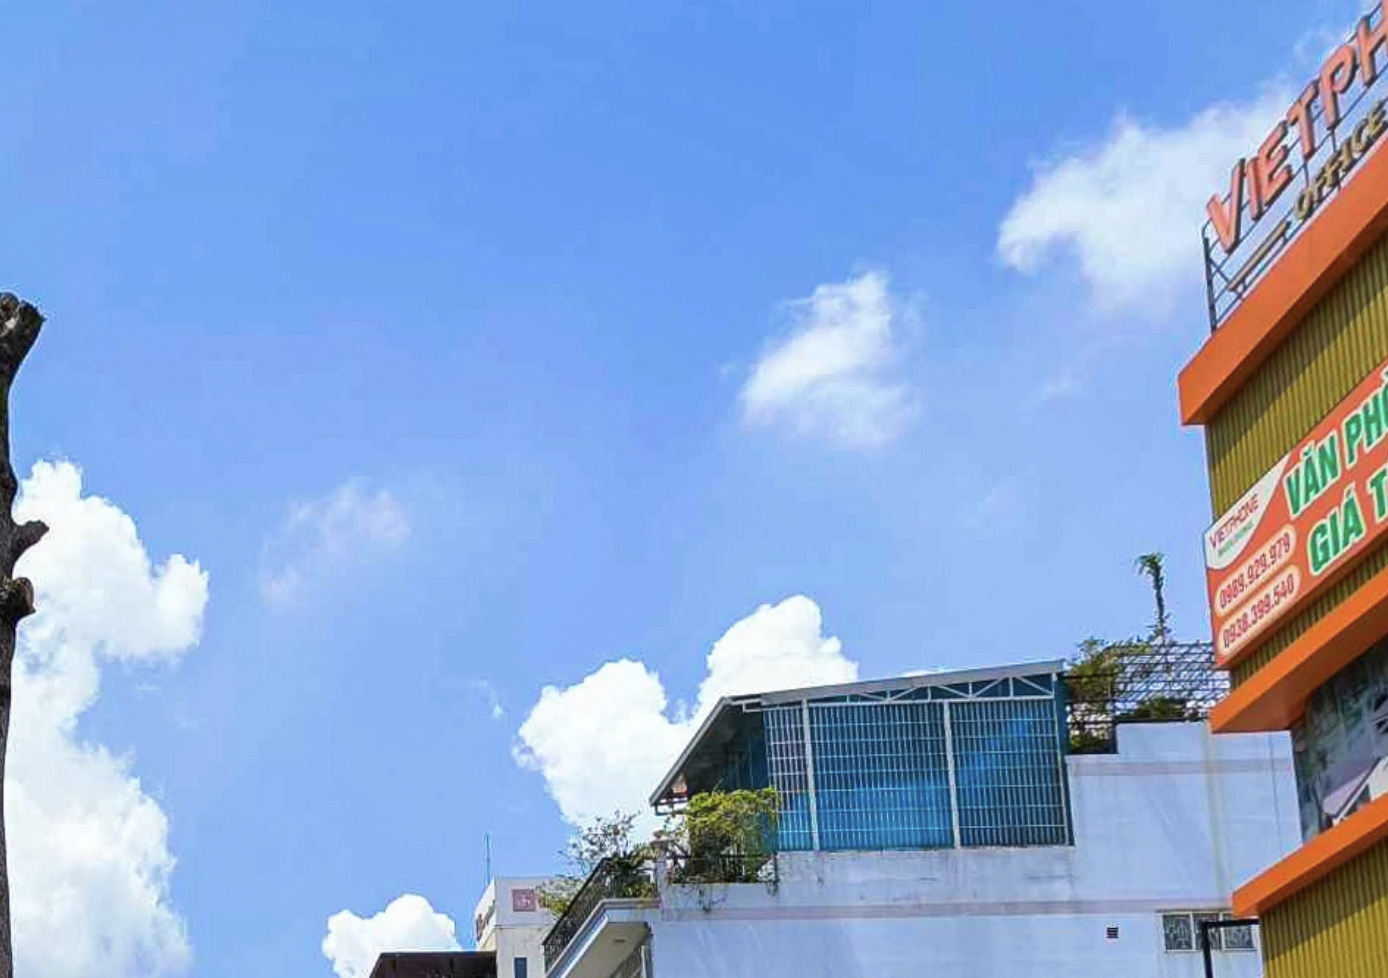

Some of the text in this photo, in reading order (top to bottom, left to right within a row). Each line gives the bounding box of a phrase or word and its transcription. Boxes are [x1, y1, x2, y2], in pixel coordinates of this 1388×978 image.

[1284, 430, 1340, 518] VĂN
[1209, 494, 1258, 548] VIETPHONE
[1308, 484, 1366, 575] GIÁ
